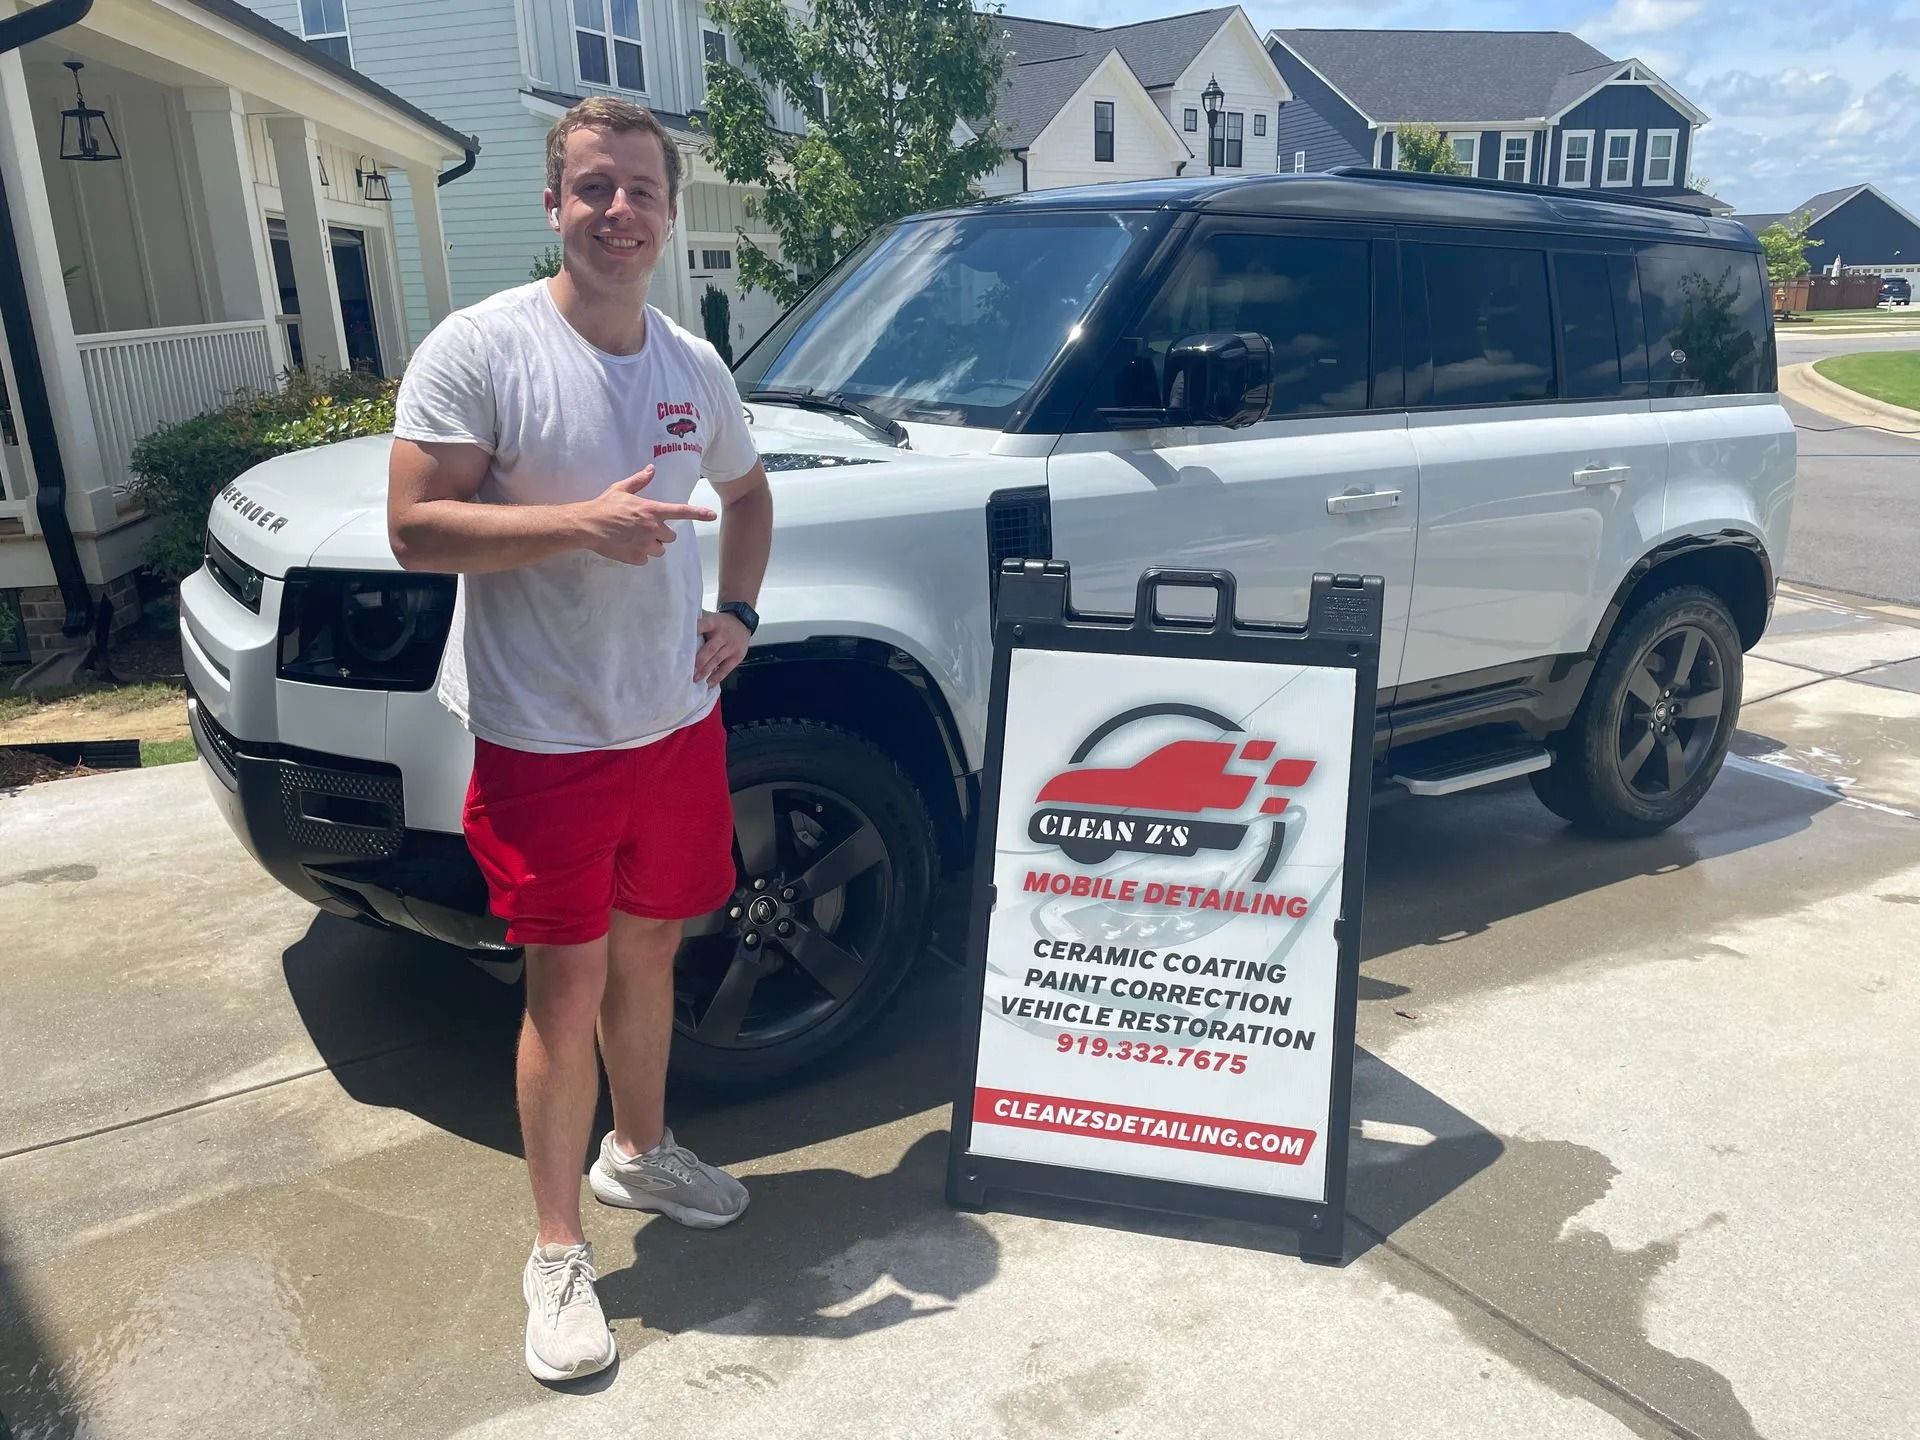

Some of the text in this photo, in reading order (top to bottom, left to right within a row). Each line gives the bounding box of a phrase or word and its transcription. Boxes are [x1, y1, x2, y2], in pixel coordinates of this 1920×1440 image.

[653, 442, 682, 458] Mobile
[221, 482, 289, 534] DEFENDER
[1039, 814, 1190, 847] CLEAN Z'S
[1023, 871, 1308, 919] MOBILE DETAILING
[1033, 939, 1287, 984] CERAMIC COATING
[1024, 968, 1292, 1017] PAINT CORRECTION
[1001, 995, 1316, 1051] VEHICLE RESTORATION
[1056, 1033, 1248, 1074] 919.332.7675
[994, 1098, 1305, 1157] CLEANZSDETAILING.COM
